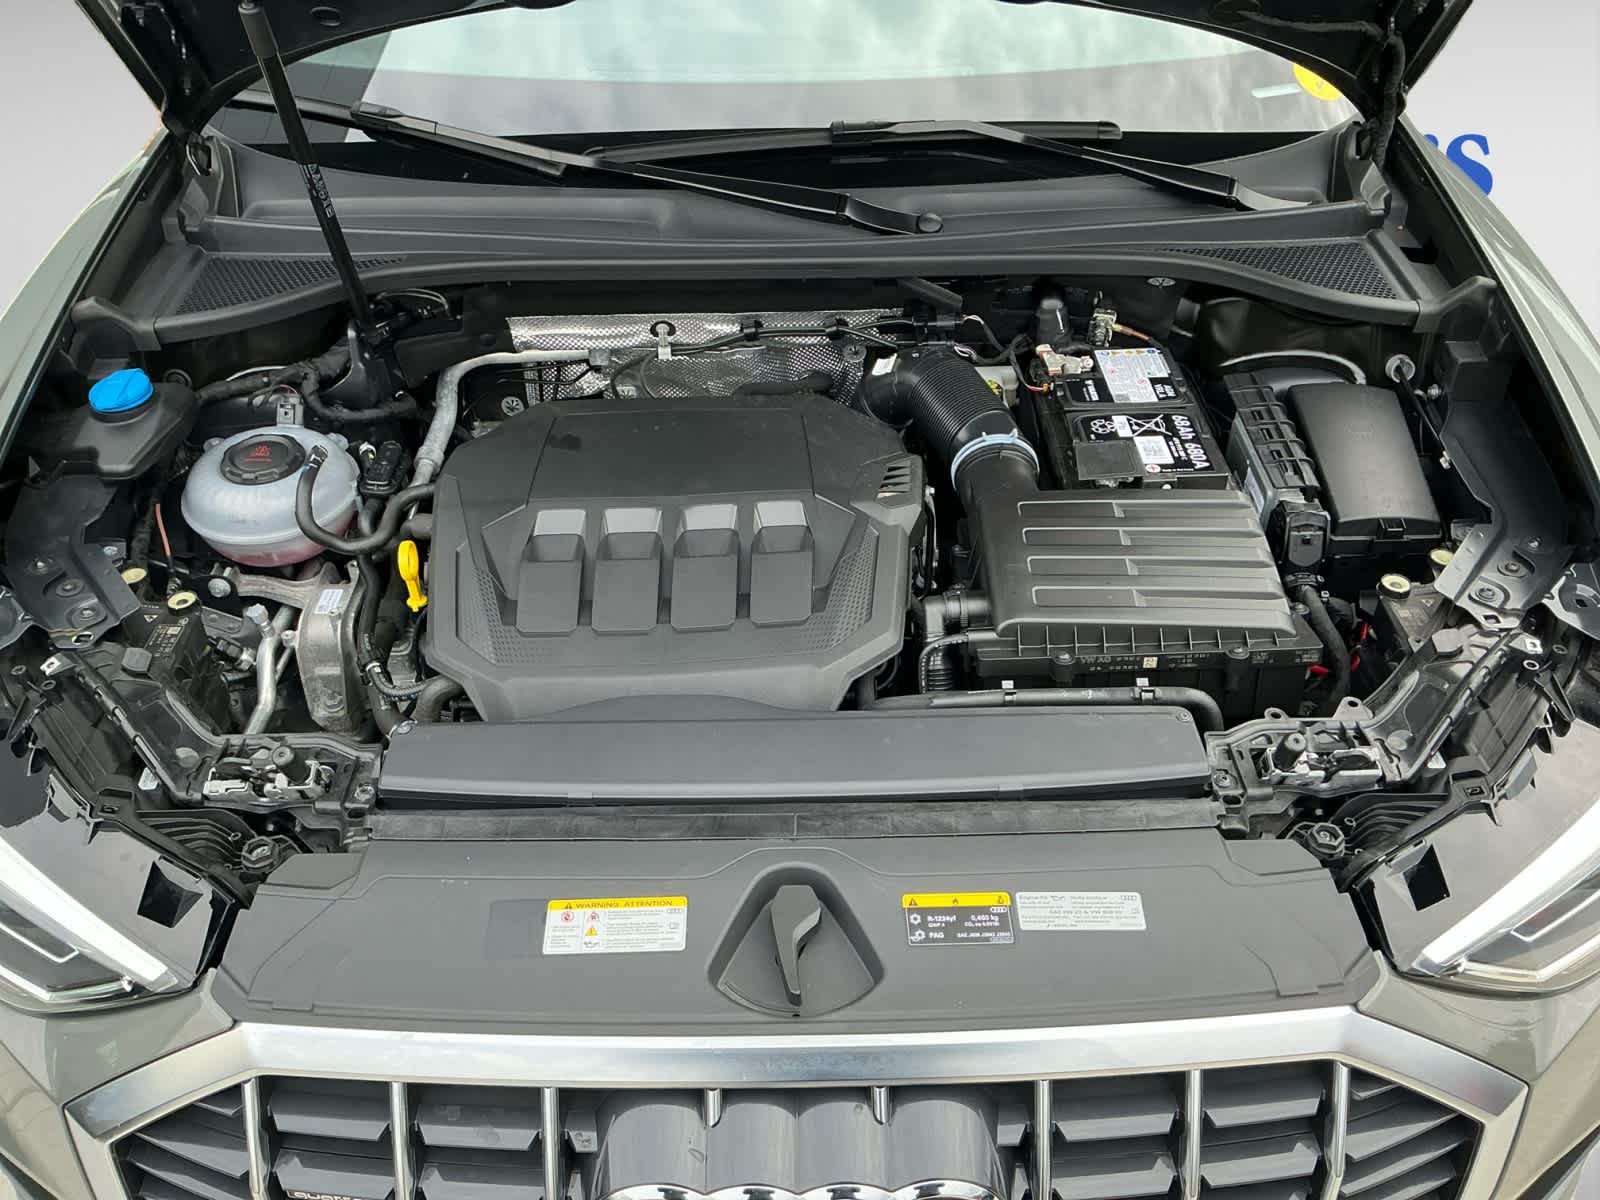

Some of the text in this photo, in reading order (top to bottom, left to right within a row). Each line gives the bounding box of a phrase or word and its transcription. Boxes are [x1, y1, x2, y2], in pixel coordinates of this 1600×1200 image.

[1171, 414, 1197, 440] 68Ah
[1184, 442, 1211, 470] 680A
[575, 900, 673, 909] WARNING ATTENTION
